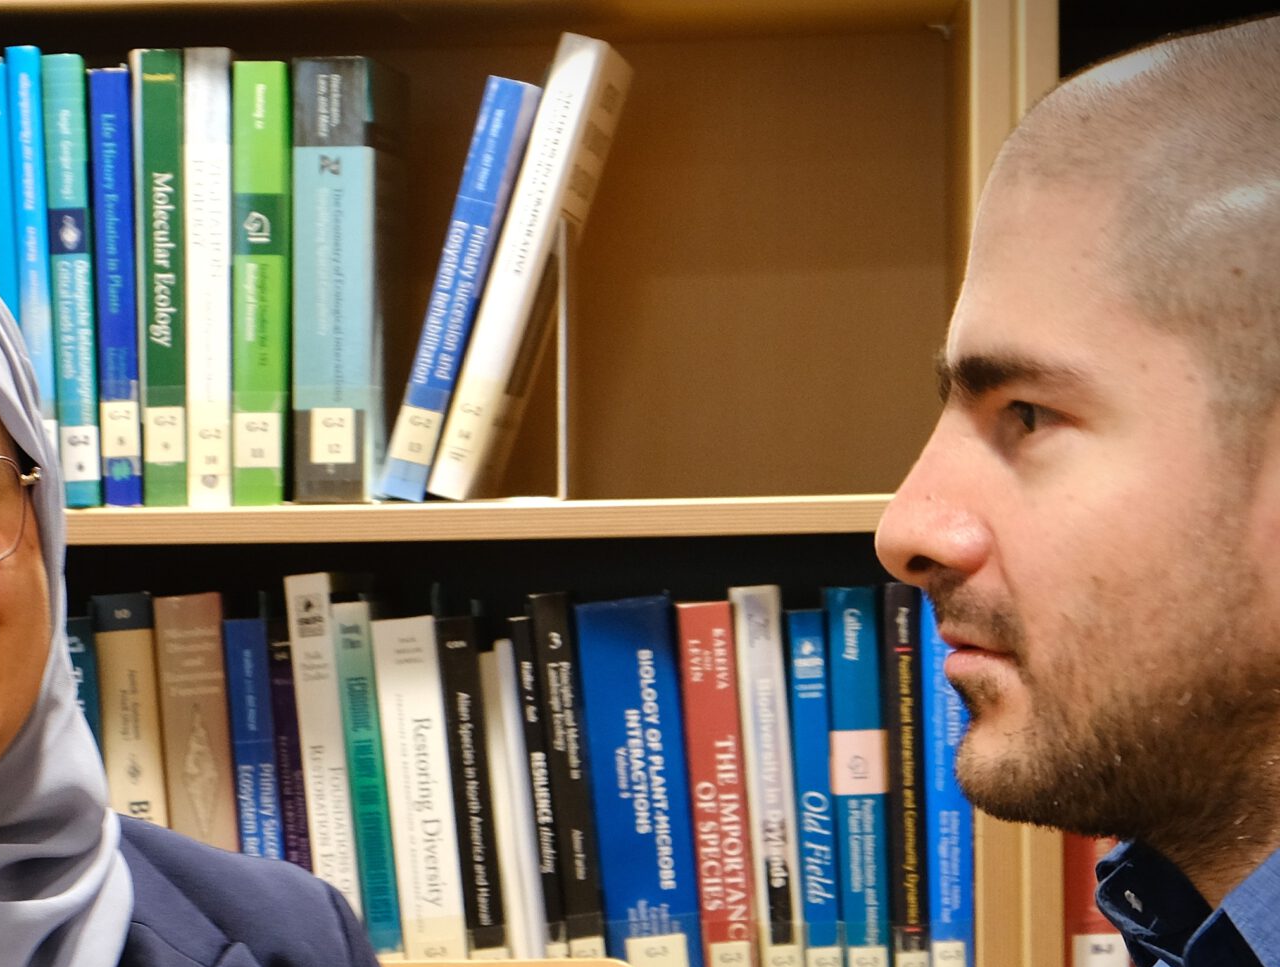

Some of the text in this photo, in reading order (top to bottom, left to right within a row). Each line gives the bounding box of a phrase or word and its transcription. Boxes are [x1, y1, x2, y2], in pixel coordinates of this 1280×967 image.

[100, 113, 123, 314] Life History Evolution in Plants
[333, 188, 344, 207] The
[149, 173, 177, 347] Molecular Ecology
[331, 209, 345, 263] Geometry
[56, 261, 73, 298] Critical
[333, 264, 345, 277] of
[59, 301, 74, 334] Loads
[331, 279, 345, 336] Ecological
[412, 220, 469, 384] Ecosystem Rehabilitation
[434, 224, 489, 380] Primary Succession and
[62, 345, 77, 379] Levels
[688, 639, 704, 682] LEVIN
[712, 628, 731, 690] KAREIVA
[841, 608, 862, 661] Callaway
[637, 649, 660, 724] BIOLOGY
[899, 655, 913, 695] Positive
[551, 713, 567, 751] Ecology
[563, 709, 577, 727] and
[900, 697, 914, 723] Plant
[566, 728, 581, 768] Methods
[645, 728, 662, 750] OF
[901, 725, 916, 787] Interactions
[258, 763, 277, 816] Primary
[309, 745, 328, 847] RESTORATION
[614, 748, 629, 790] Volume
[624, 709, 652, 834] INTERACTIONS
[757, 678, 789, 889] Biodiversity in Drylands
[238, 765, 259, 834] Ecosystem
[411, 718, 449, 907] Restoring Diversity
[456, 692, 495, 926] Alien Species in North America and Hawaii
[530, 752, 557, 874] RESILIENCE thinking
[648, 755, 677, 890] PLANT-MICROBE
[848, 809, 862, 833] Plant
[862, 799, 876, 833] Positive
[903, 788, 917, 809] and
[695, 782, 725, 912] OF SPECIES
[714, 734, 751, 940] THE IMPORTANC
[802, 790, 836, 905] Old Fields
[849, 834, 863, 893] Communities
[862, 835, 877, 887] Interactions
[901, 810, 919, 871] Community
[866, 888, 878, 905] and
[903, 874, 920, 925] Dynamics
